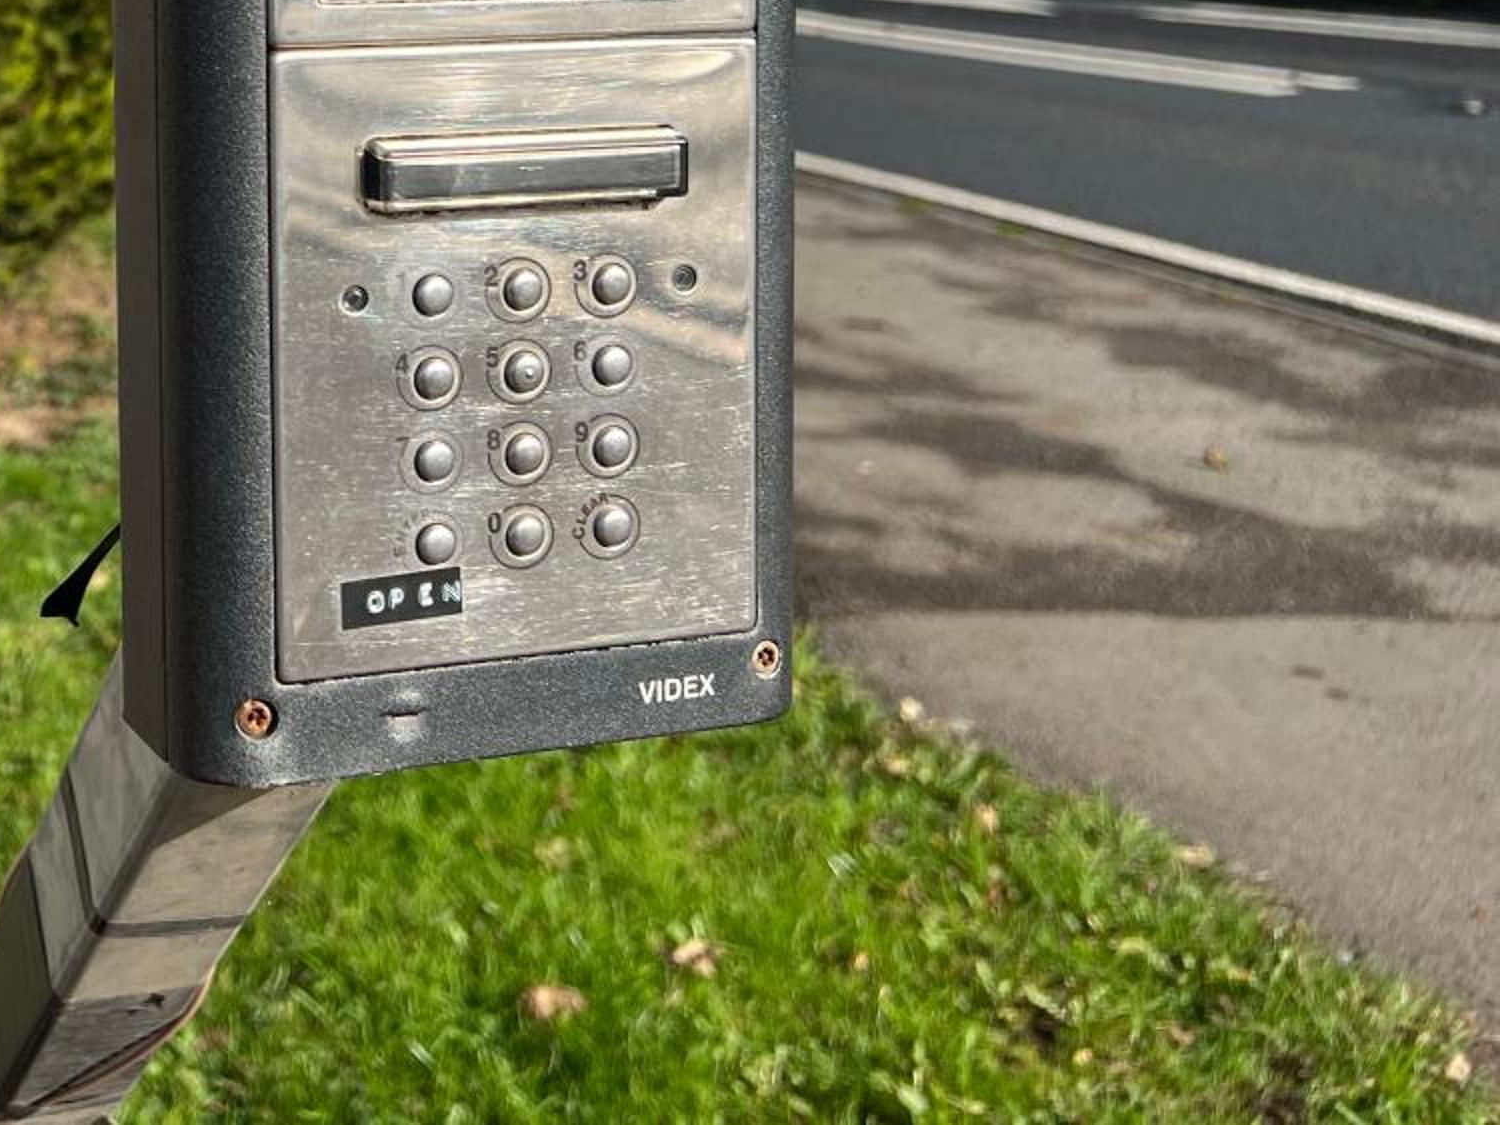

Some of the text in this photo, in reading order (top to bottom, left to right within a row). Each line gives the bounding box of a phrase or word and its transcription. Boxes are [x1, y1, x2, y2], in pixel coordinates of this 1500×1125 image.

[484, 265, 498, 287] 2
[573, 259, 587, 281] 3
[486, 346, 499, 368] 5
[573, 340, 587, 362] 6
[396, 353, 409, 374] 4
[487, 429, 501, 450] 8
[575, 421, 589, 442] 9
[487, 512, 502, 534] 0
[571, 492, 609, 540] CLEAR
[638, 672, 716, 705] VIDEX
